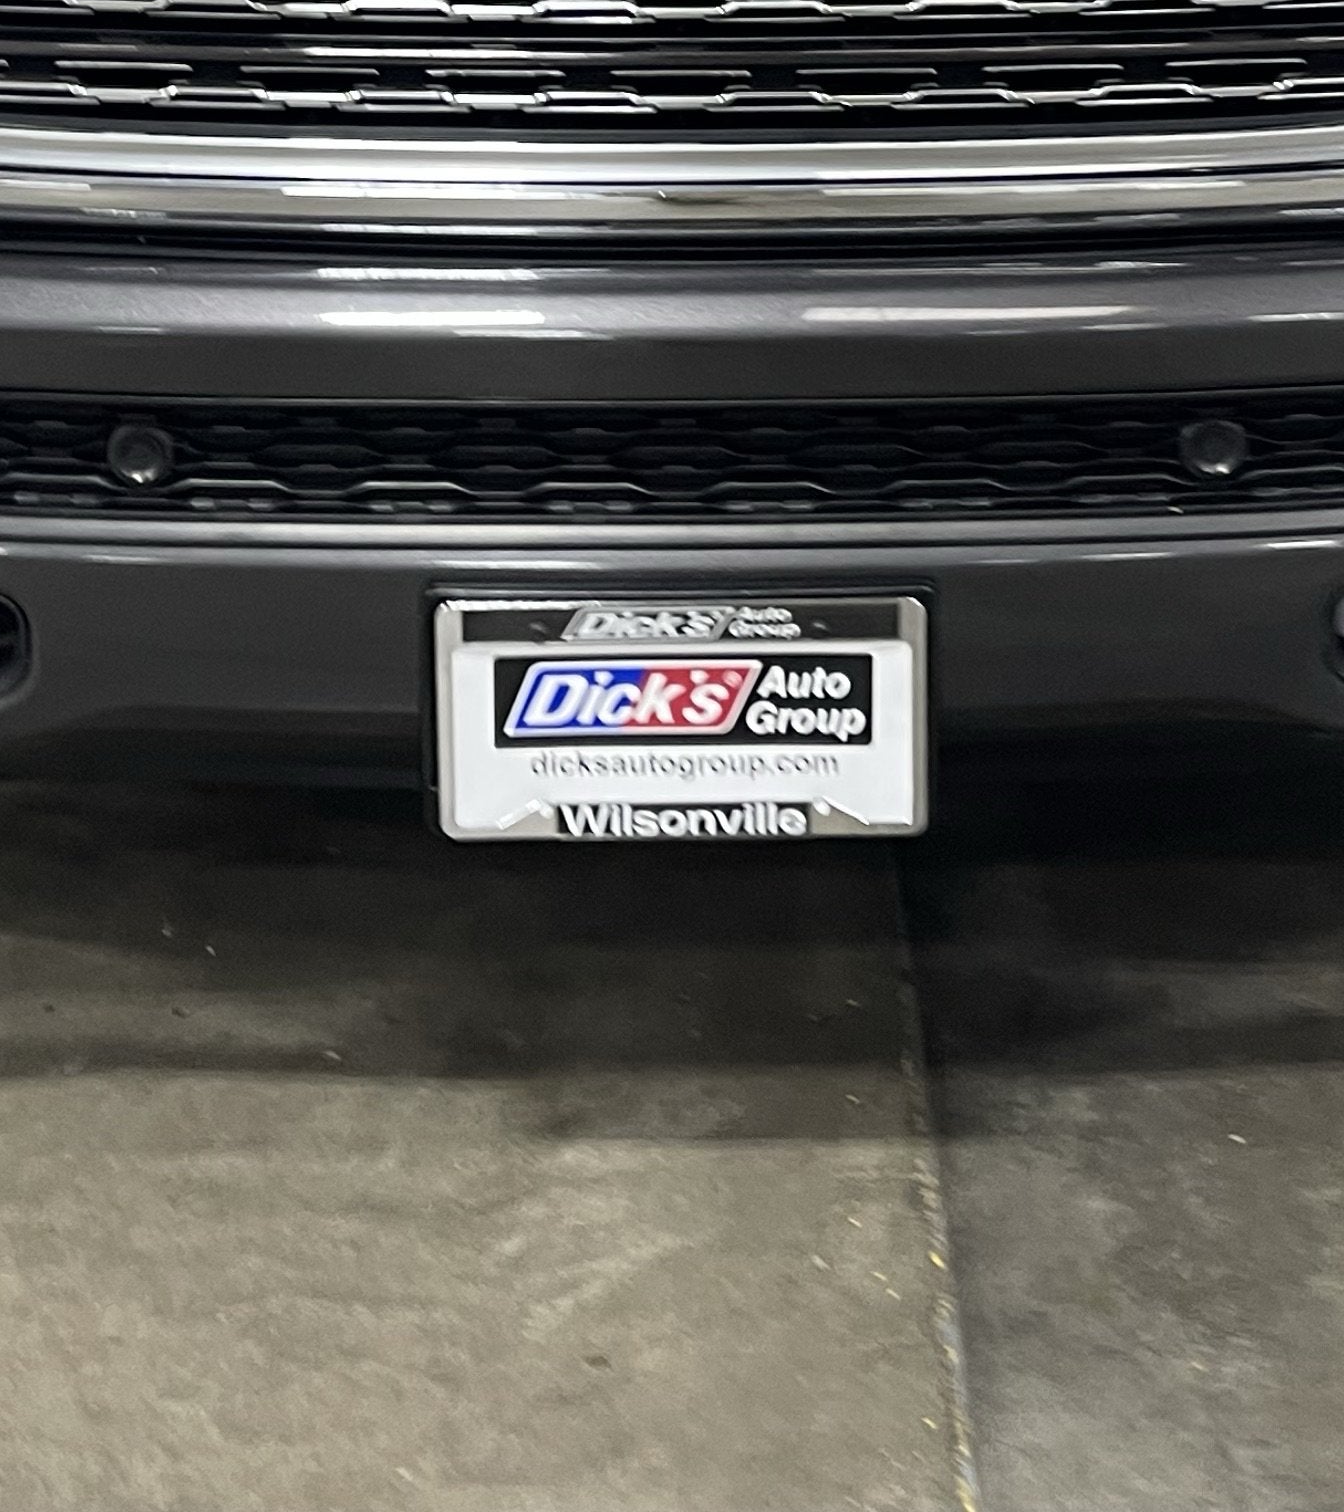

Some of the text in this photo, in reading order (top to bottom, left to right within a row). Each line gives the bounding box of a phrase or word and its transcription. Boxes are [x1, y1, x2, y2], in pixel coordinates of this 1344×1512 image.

[522, 669, 731, 727] Dick's
[756, 665, 852, 700] Auto
[745, 699, 868, 742] Group
[530, 750, 840, 780] dicksautogroup.com
[558, 802, 808, 838] Wilsonville
